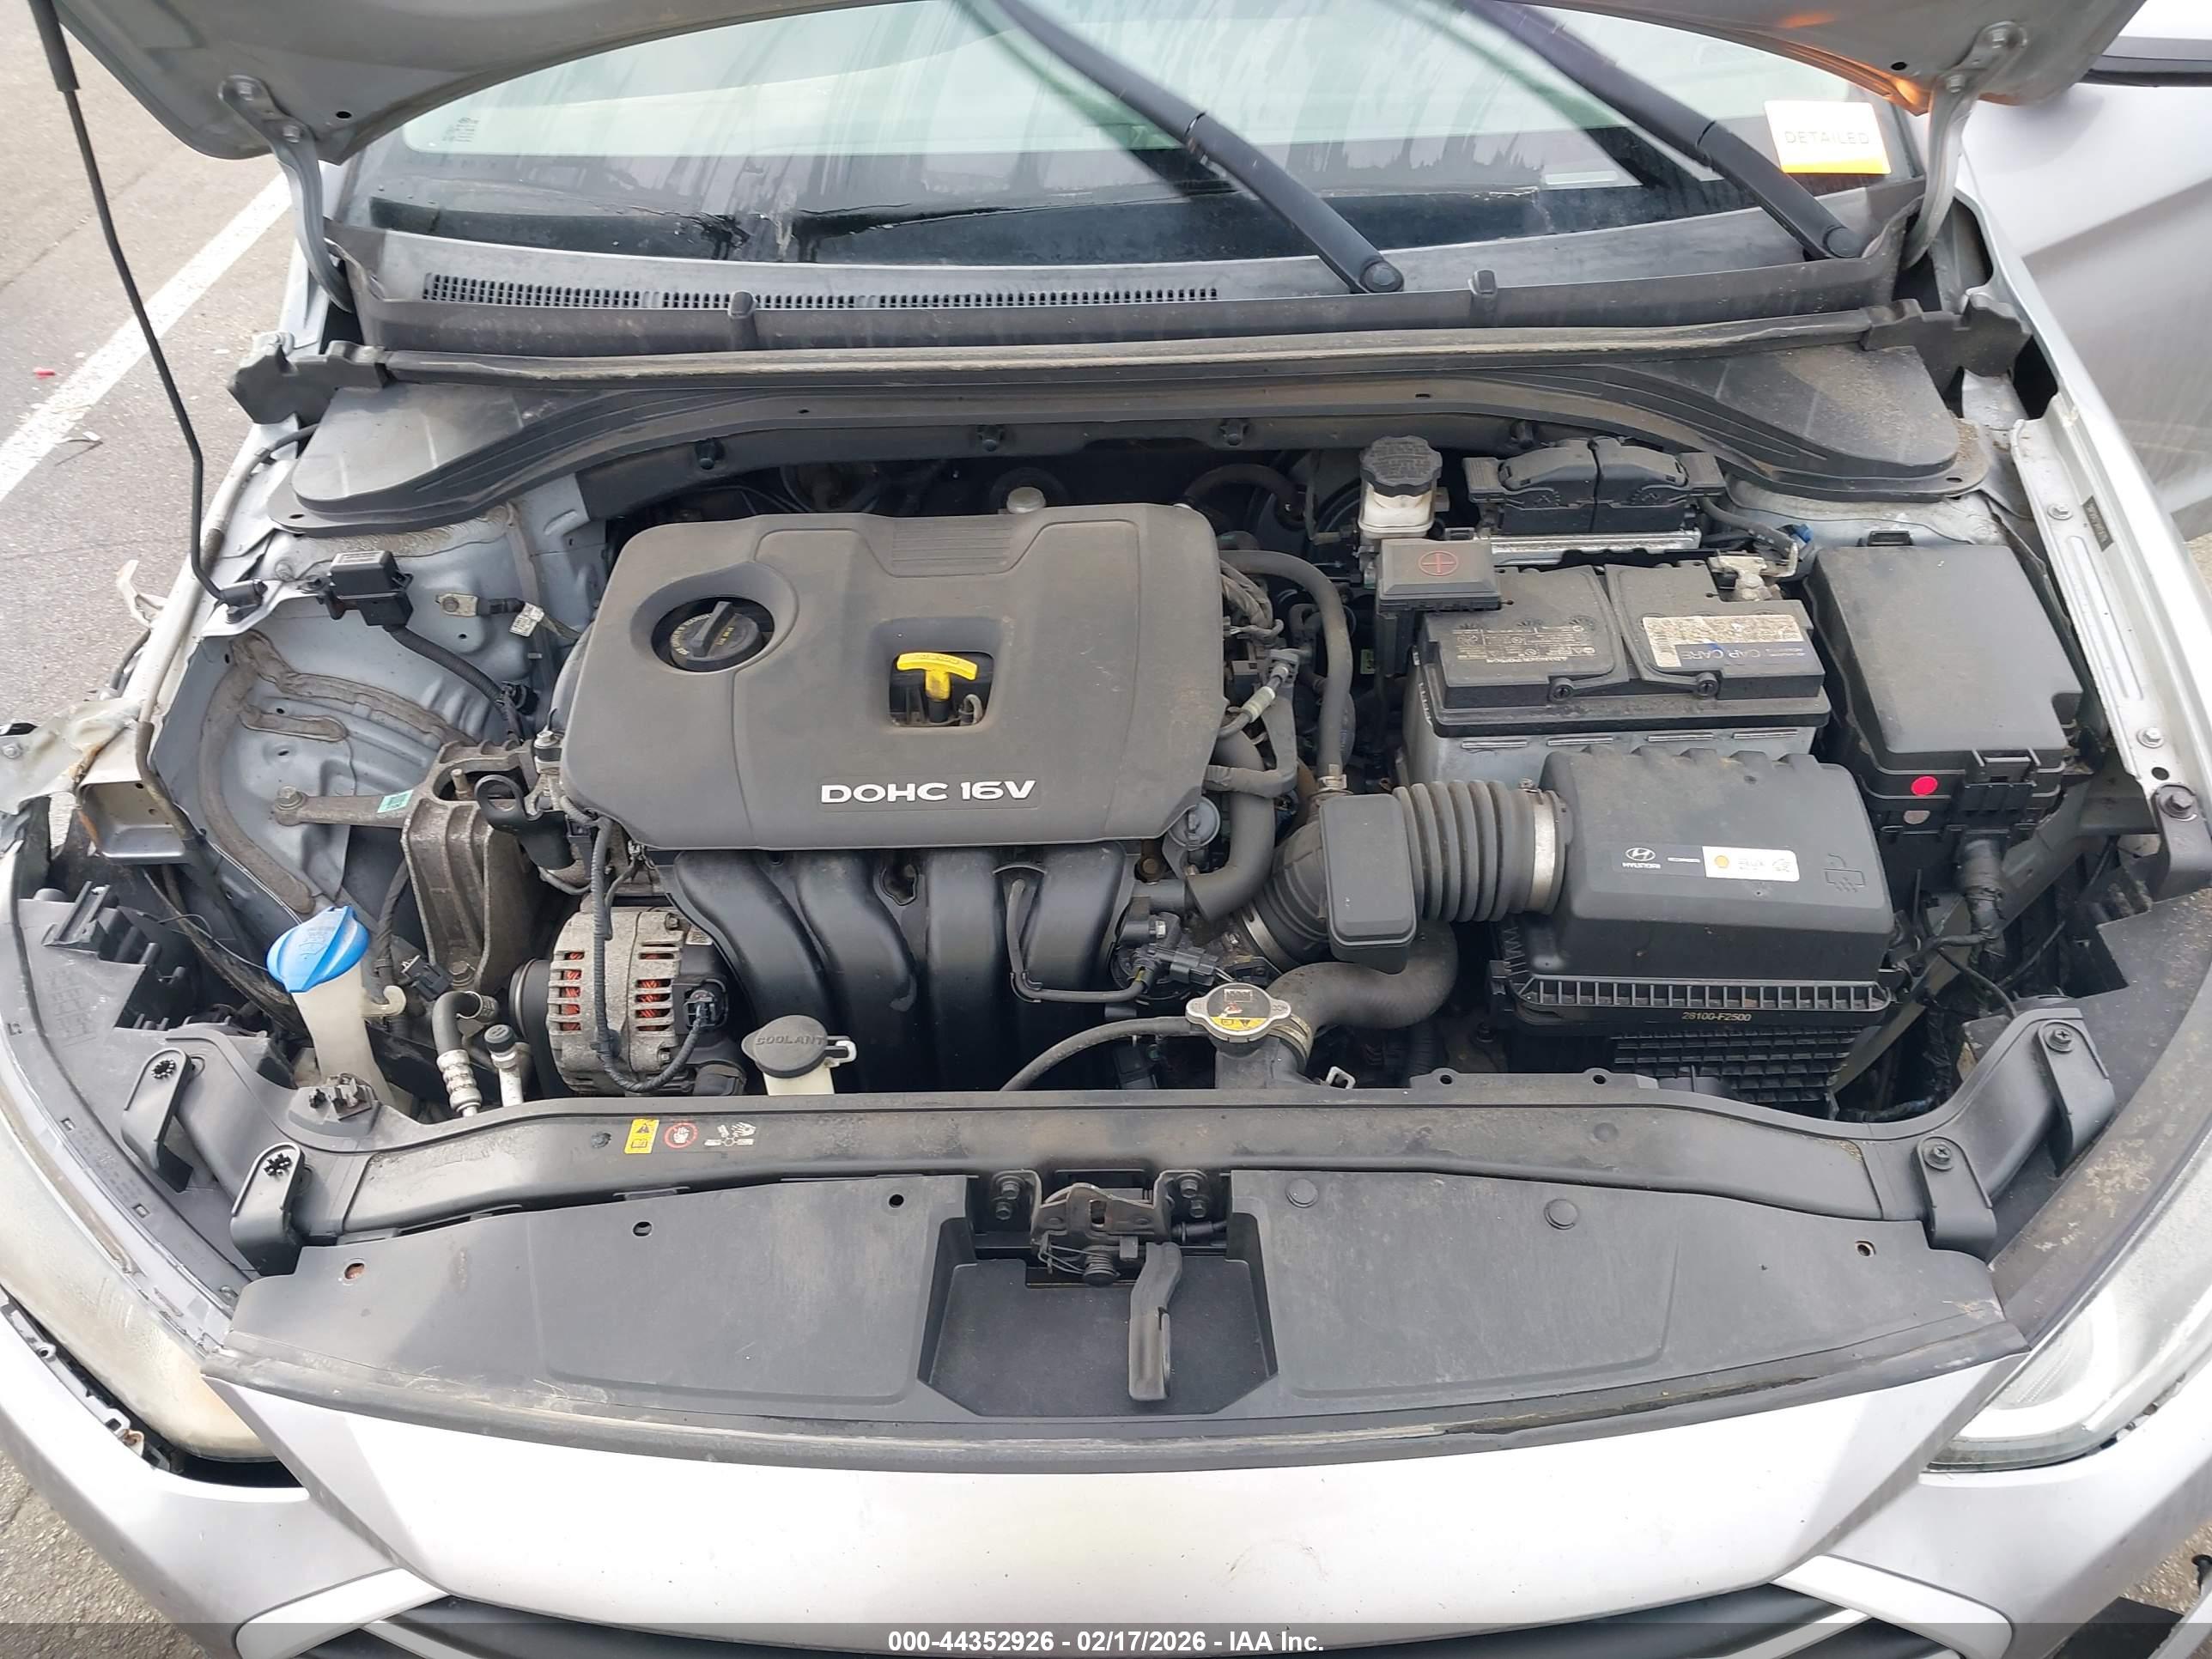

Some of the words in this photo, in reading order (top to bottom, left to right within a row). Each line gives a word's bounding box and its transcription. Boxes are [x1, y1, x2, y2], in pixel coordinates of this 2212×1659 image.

[1784, 131, 1869, 144] DETAILED
[1681, 649, 1724, 659] CARE
[822, 783, 948, 802] DOHC
[961, 781, 1035, 799] 16V
[756, 1035, 825, 1046] COOLANT
